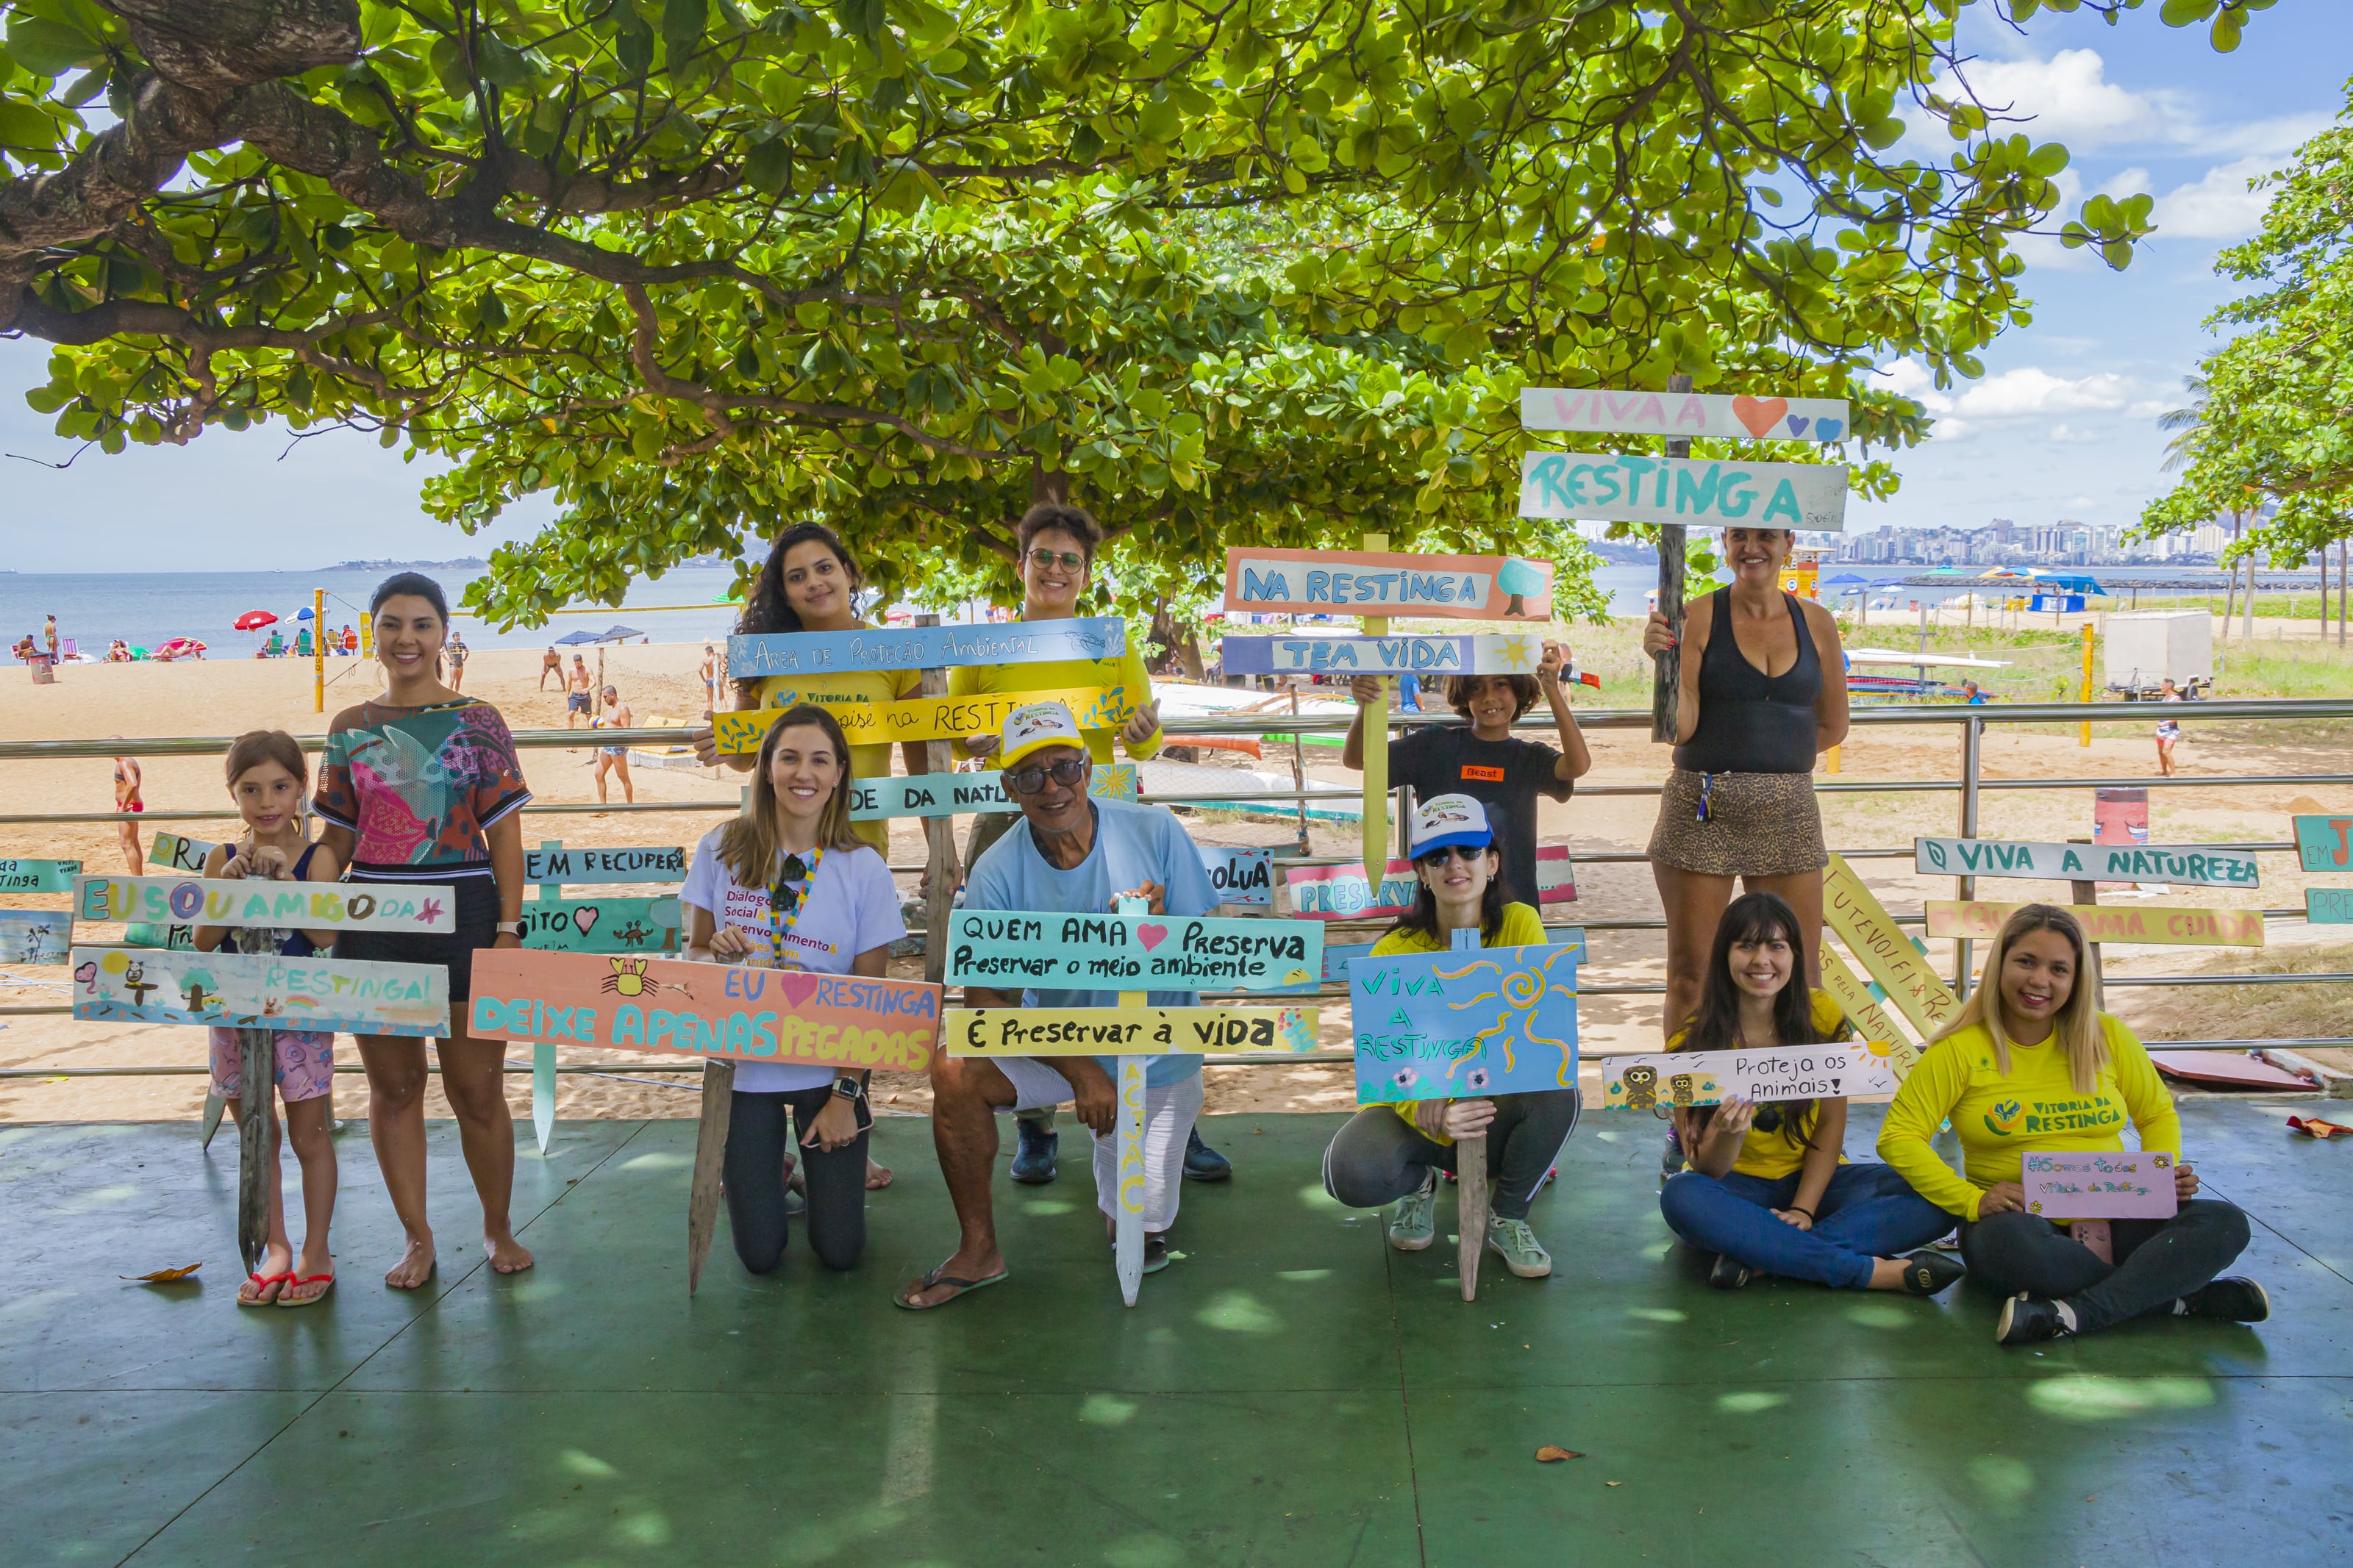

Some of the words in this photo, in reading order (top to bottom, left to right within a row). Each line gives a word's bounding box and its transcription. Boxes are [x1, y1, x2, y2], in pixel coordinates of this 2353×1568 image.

[1553, 393, 1666, 425] VIVA
[1675, 394, 1706, 427] A
[1244, 568, 1290, 601] NA
[813, 648, 832, 666] DE
[1283, 642, 1358, 669] TEM
[887, 710, 919, 728] na
[1467, 768, 1497, 778] Beast
[904, 788, 936, 809] DA
[526, 853, 571, 879] EM
[1957, 843, 2034, 870] VIVA
[2061, 850, 2085, 872] A
[2107, 850, 2259, 883] NATUREZA
[2307, 845, 2329, 864] EM
[82, 879, 138, 920] EU
[144, 881, 235, 921] SOU
[242, 892, 376, 923] AMIGO
[380, 899, 415, 918] DA
[1300, 880, 1418, 912] PRESERV
[963, 917, 1042, 942] QUEM
[1062, 918, 1127, 947] AMA
[2167, 912, 2264, 940] CUIDA
[954, 945, 1058, 978] Preservar
[1066, 961, 1080, 975] o
[1089, 958, 1141, 978] meio
[1151, 955, 1267, 978] ambiente
[724, 970, 765, 1002] EU
[815, 978, 935, 1019] RESTINGA
[968, 1009, 988, 1048] É
[1153, 1011, 1173, 1046] à
[1388, 1005, 1413, 1029] A
[612, 1003, 777, 1057] APENAS
[781, 1015, 931, 1071] PEGADAS
[1736, 1056, 1815, 1081] Proteja
[2094, 1096, 2111, 1107] DA
[2026, 1109, 2121, 1133] RESTINGA
